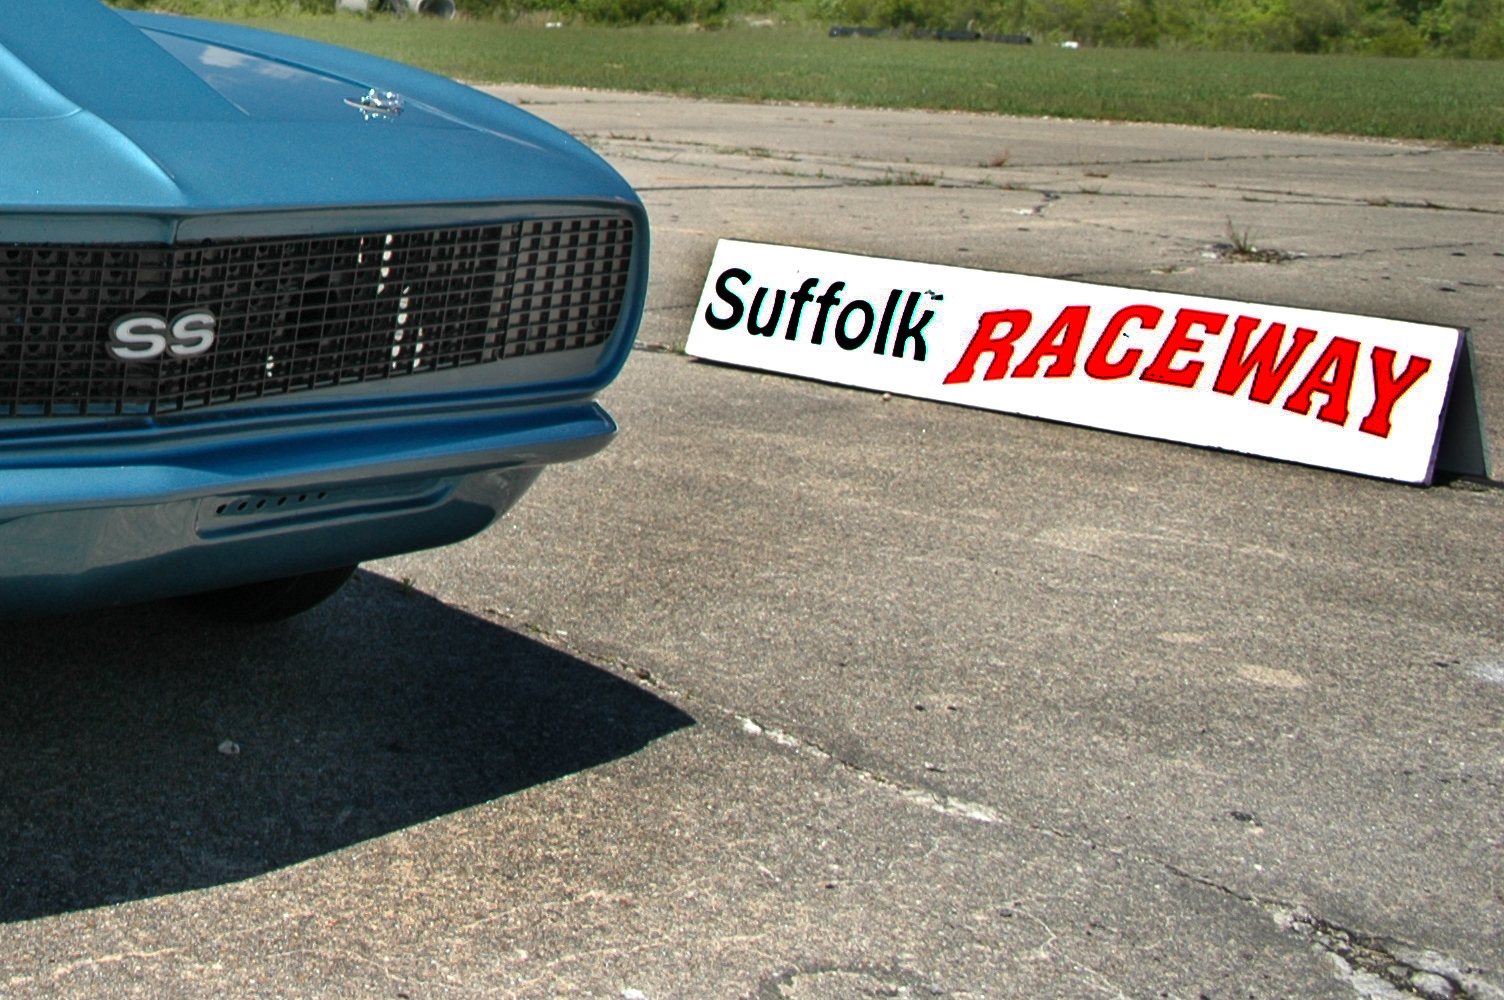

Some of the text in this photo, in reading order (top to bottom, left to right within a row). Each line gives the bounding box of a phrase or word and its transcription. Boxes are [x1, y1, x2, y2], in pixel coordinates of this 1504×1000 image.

[108, 311, 215, 360] SS
[704, 266, 1432, 439] Suffolk RACEWAY
